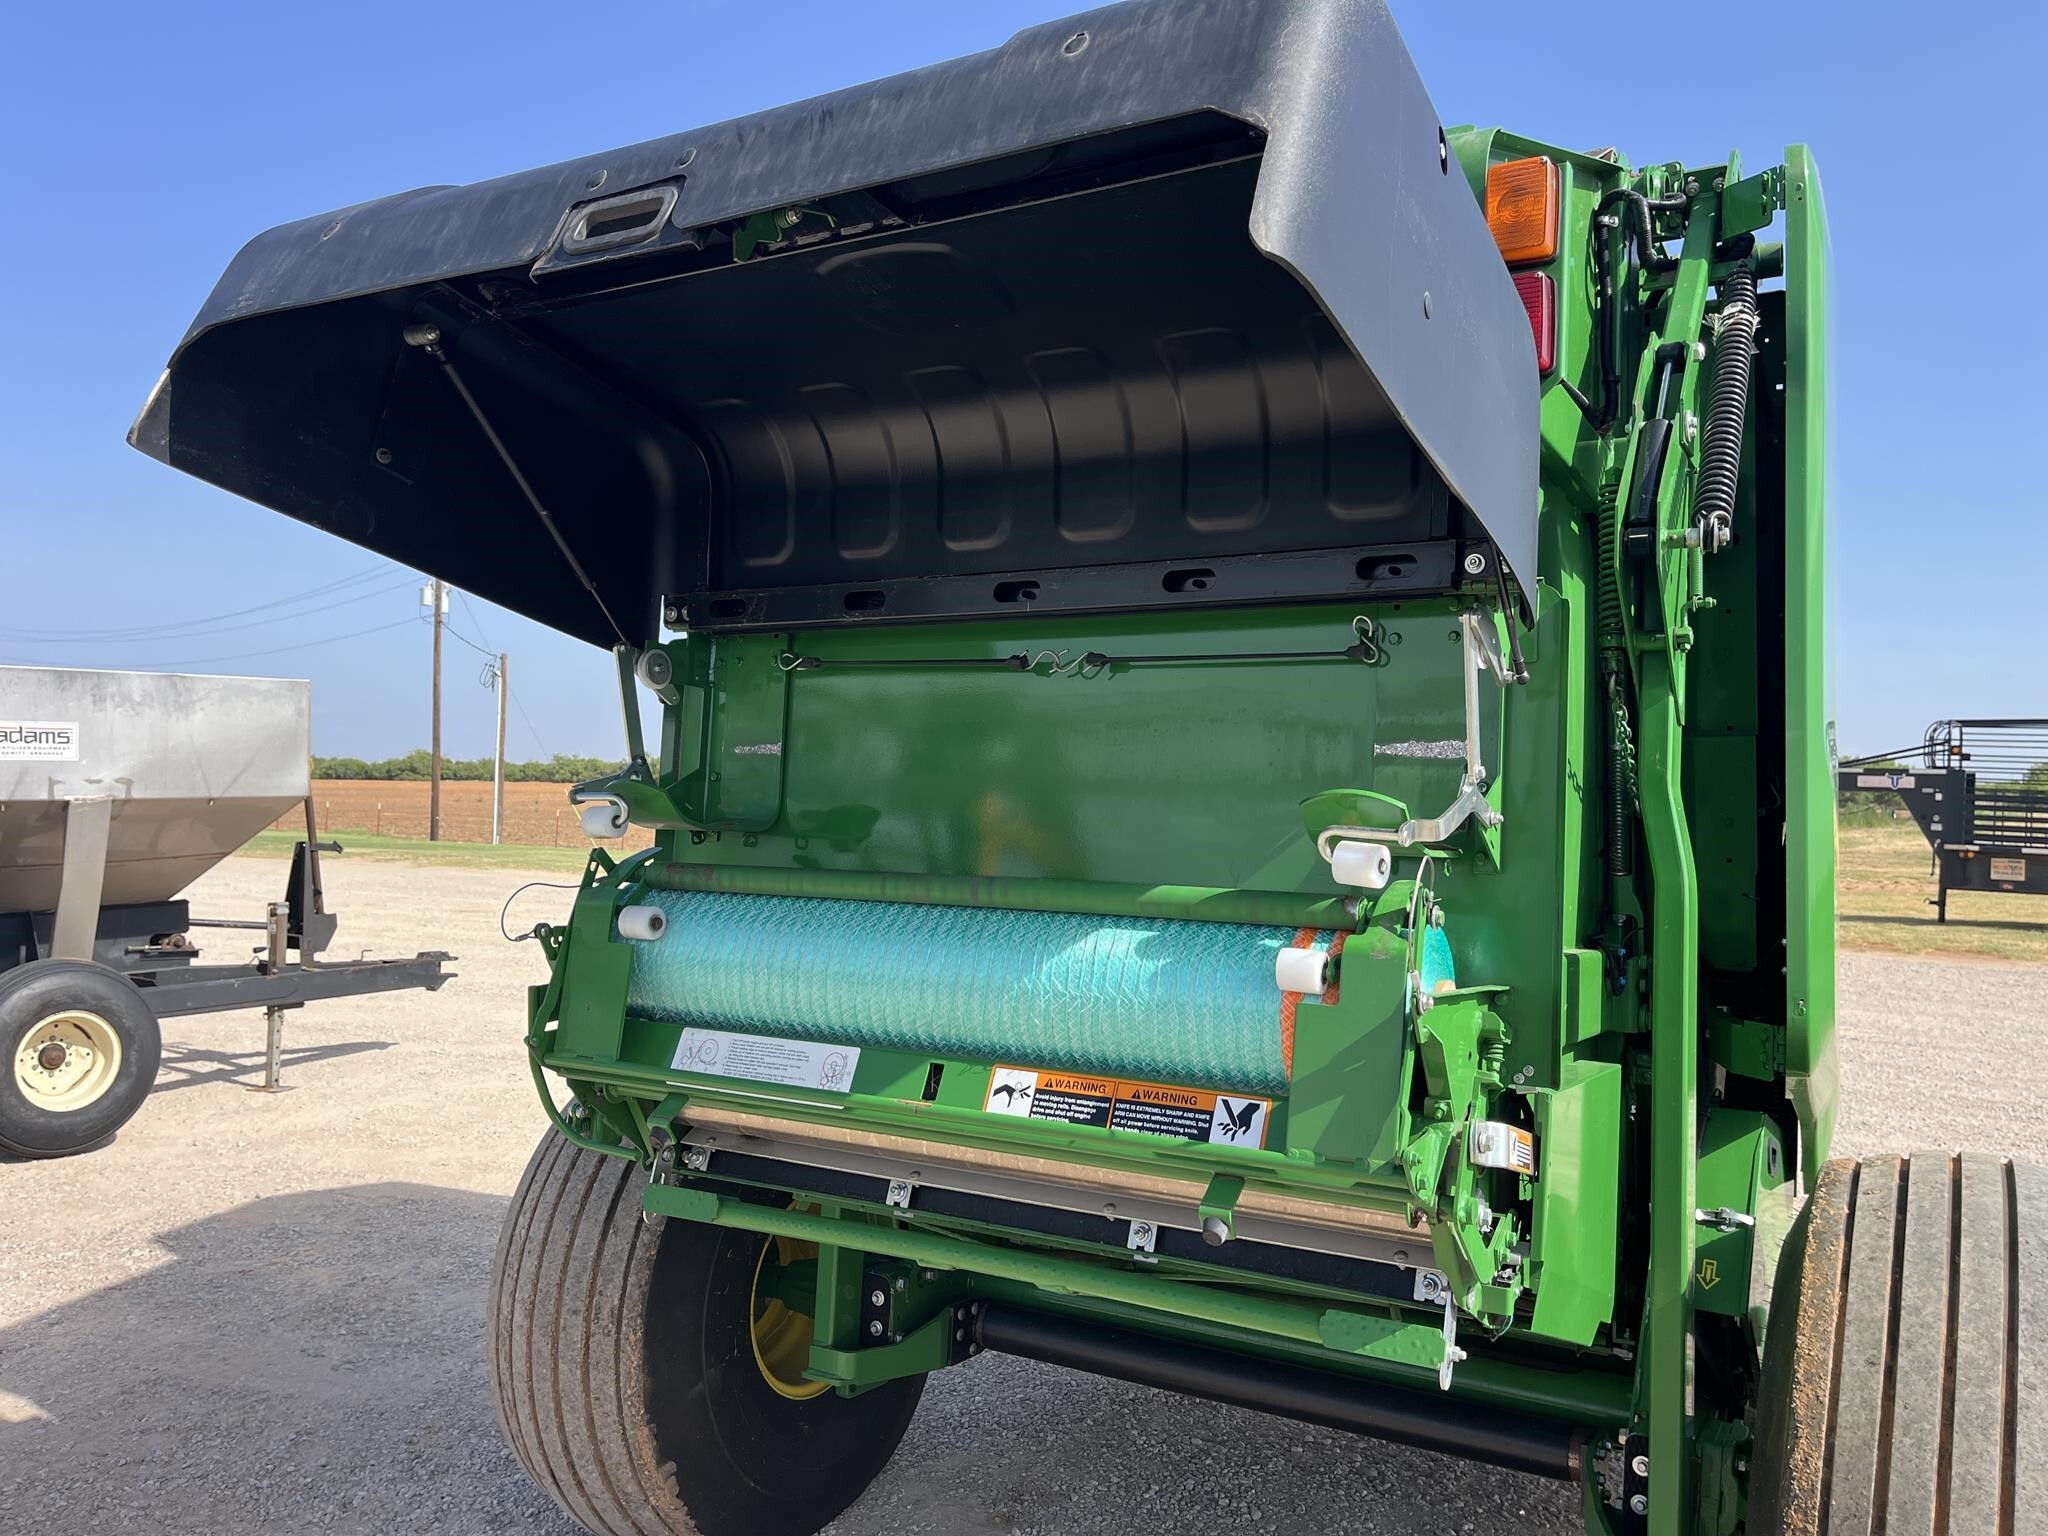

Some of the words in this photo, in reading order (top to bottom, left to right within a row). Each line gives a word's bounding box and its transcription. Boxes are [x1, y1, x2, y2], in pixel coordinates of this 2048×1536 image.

[1055, 1079, 1106, 1094] WARNING
[1143, 1089, 1198, 1105] WARNING
[1077, 1098, 1110, 1108] entanglement
[1071, 1105, 1096, 1113] Disengage
[1136, 1105, 1165, 1113] EXTREMELY
[1151, 1115, 1172, 1123] WITHOUT
[1173, 1118, 1197, 1126] WARNING.
[1161, 1124, 1184, 1133] servicing
[1184, 1127, 1199, 1135] knife.
